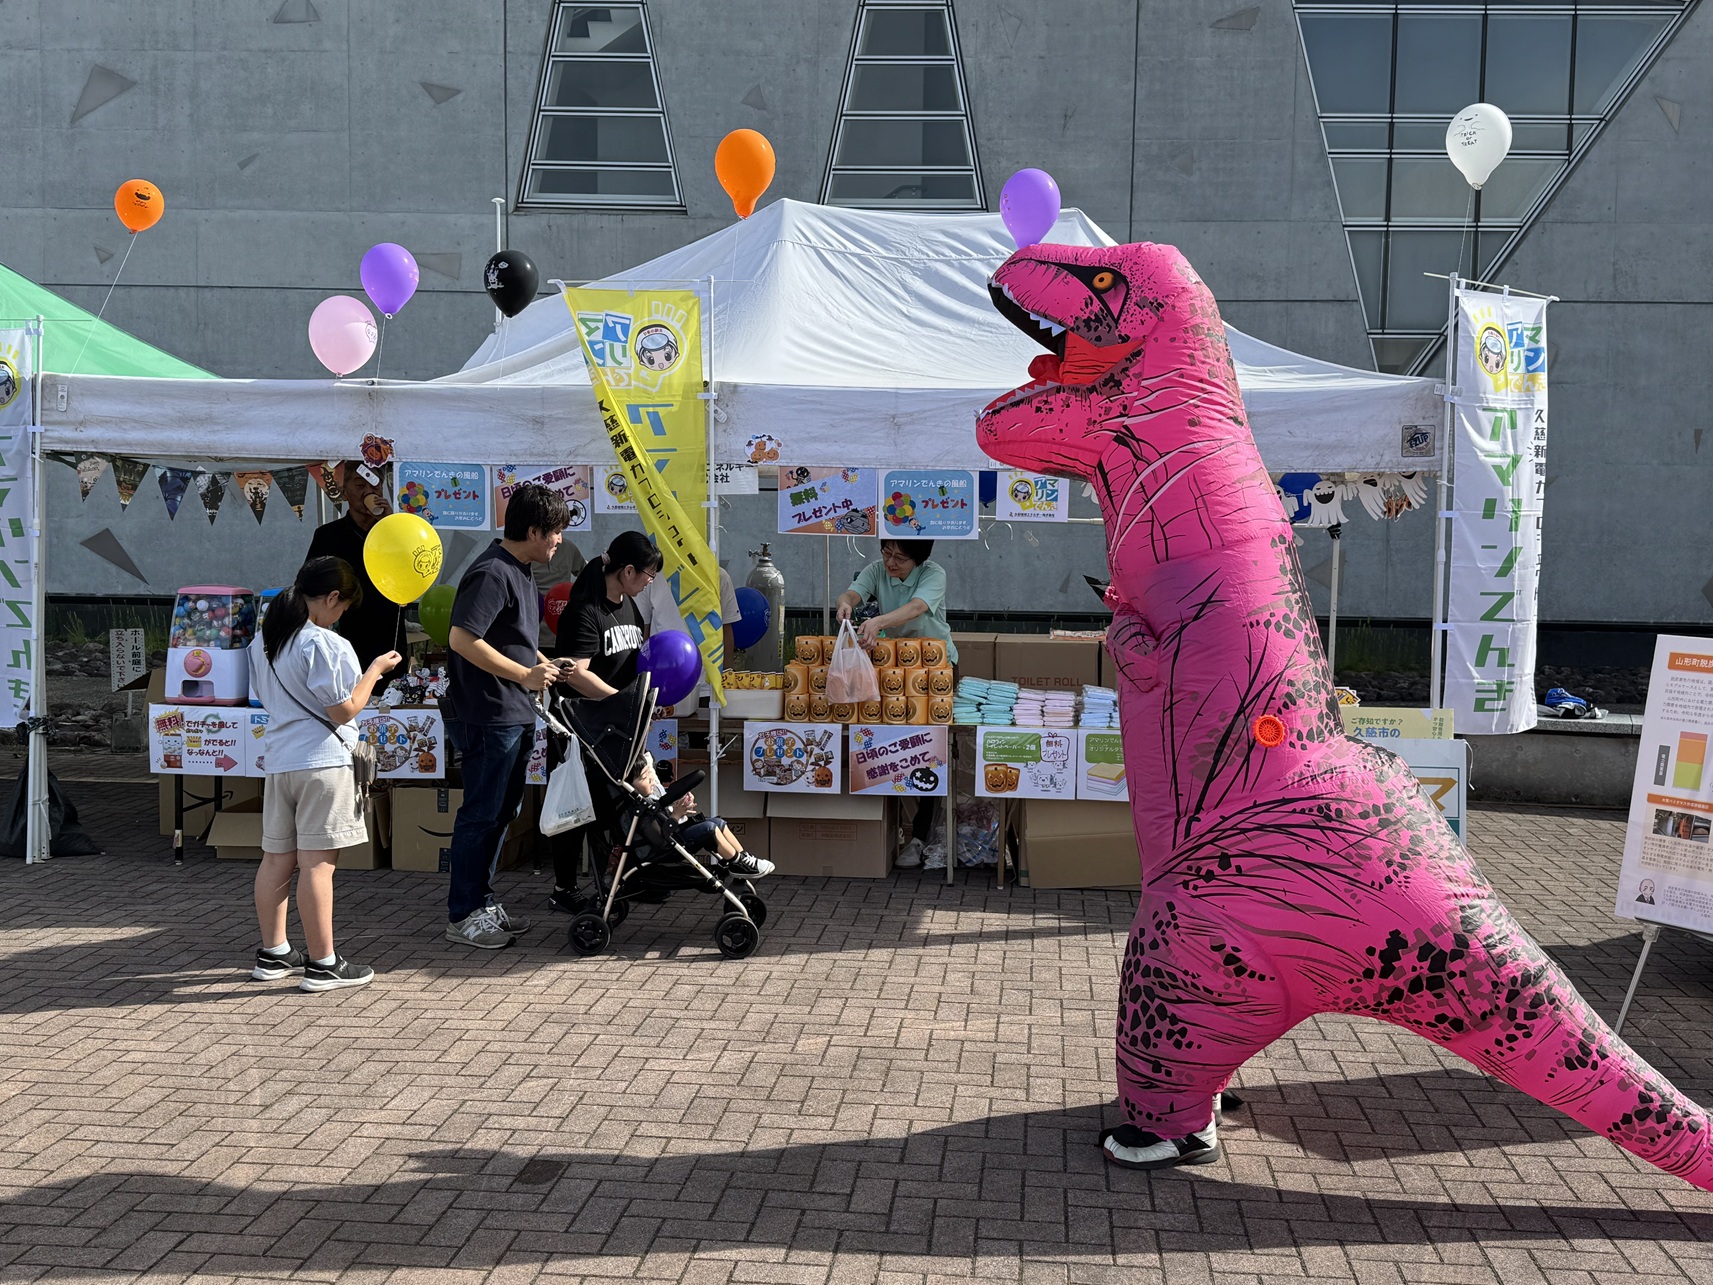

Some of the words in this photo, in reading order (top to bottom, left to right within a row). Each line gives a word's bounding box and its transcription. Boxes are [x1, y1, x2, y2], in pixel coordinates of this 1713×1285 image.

[1508, 323, 1543, 347] アマ
[1510, 348, 1546, 373] リン
[404, 469, 479, 480] アマリンでんきの風船
[890, 479, 968, 489] アマリンでんきの風船
[1034, 477, 1058, 488] アマ
[434, 489, 480, 501] プレゼント
[789, 486, 819, 507] 無料
[1034, 489, 1058, 500] リン
[921, 498, 968, 510] プレゼント
[791, 498, 854, 525] プレゼント中
[130, 629, 142, 673] ホール前庭に
[1011, 677, 1051, 687] TOILET
[1054, 678, 1084, 687] ROLL
[1351, 717, 1404, 726] ご存知ですか？
[367, 724, 399, 734] お菓子
[1353, 727, 1401, 738] 久慈市の
[765, 737, 795, 747] お菓子
[1045, 739, 1063, 748] 無料
[755, 747, 804, 758] プレゼント
[855, 731, 934, 765] 日頃のご愛顧に
[866, 750, 931, 781] 感謝をこめて
